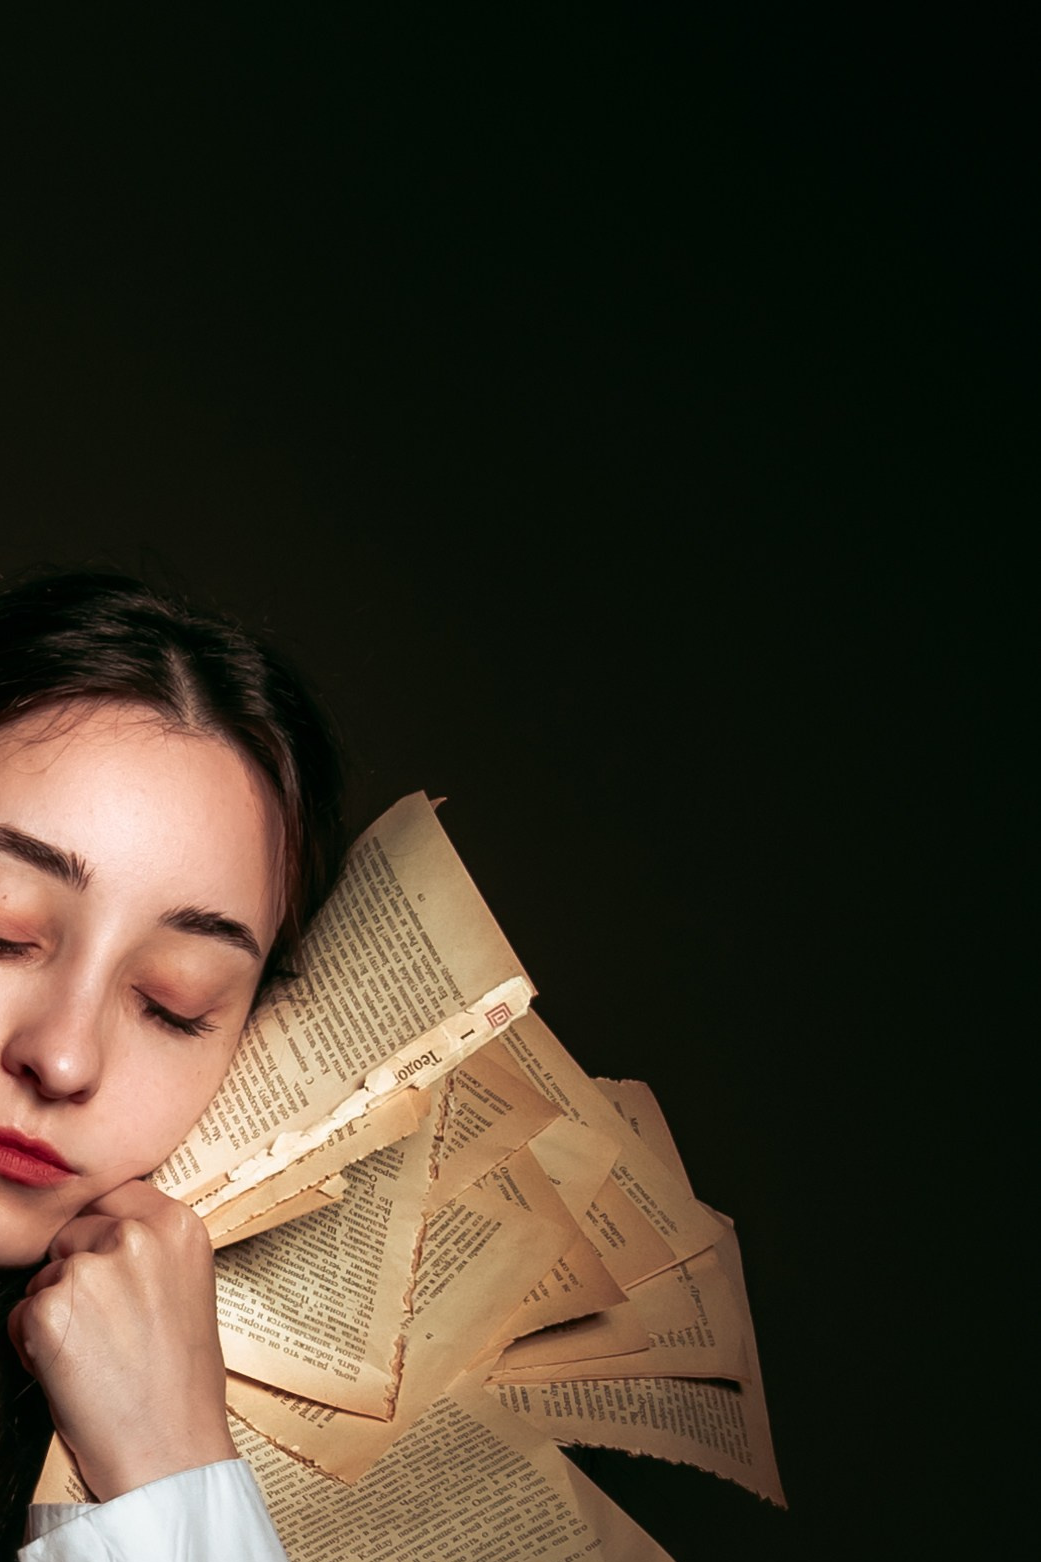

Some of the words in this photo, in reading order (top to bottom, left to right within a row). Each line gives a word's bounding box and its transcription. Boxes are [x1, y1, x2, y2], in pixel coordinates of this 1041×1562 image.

[430, 1504, 473, 1533] девушки.
[470, 1491, 492, 1508] Она
[491, 1478, 519, 1498] сразу
[516, 1466, 540, 1484] про-
[458, 1491, 518, 1529] впечатление,
[519, 1474, 547, 1493] точно
[468, 1528, 513, 1559] добиться
[512, 1521, 526, 1533] от
[527, 1507, 551, 1524] этой
[552, 1499, 569, 1512] де-
[583, 1537, 603, 1553] она
